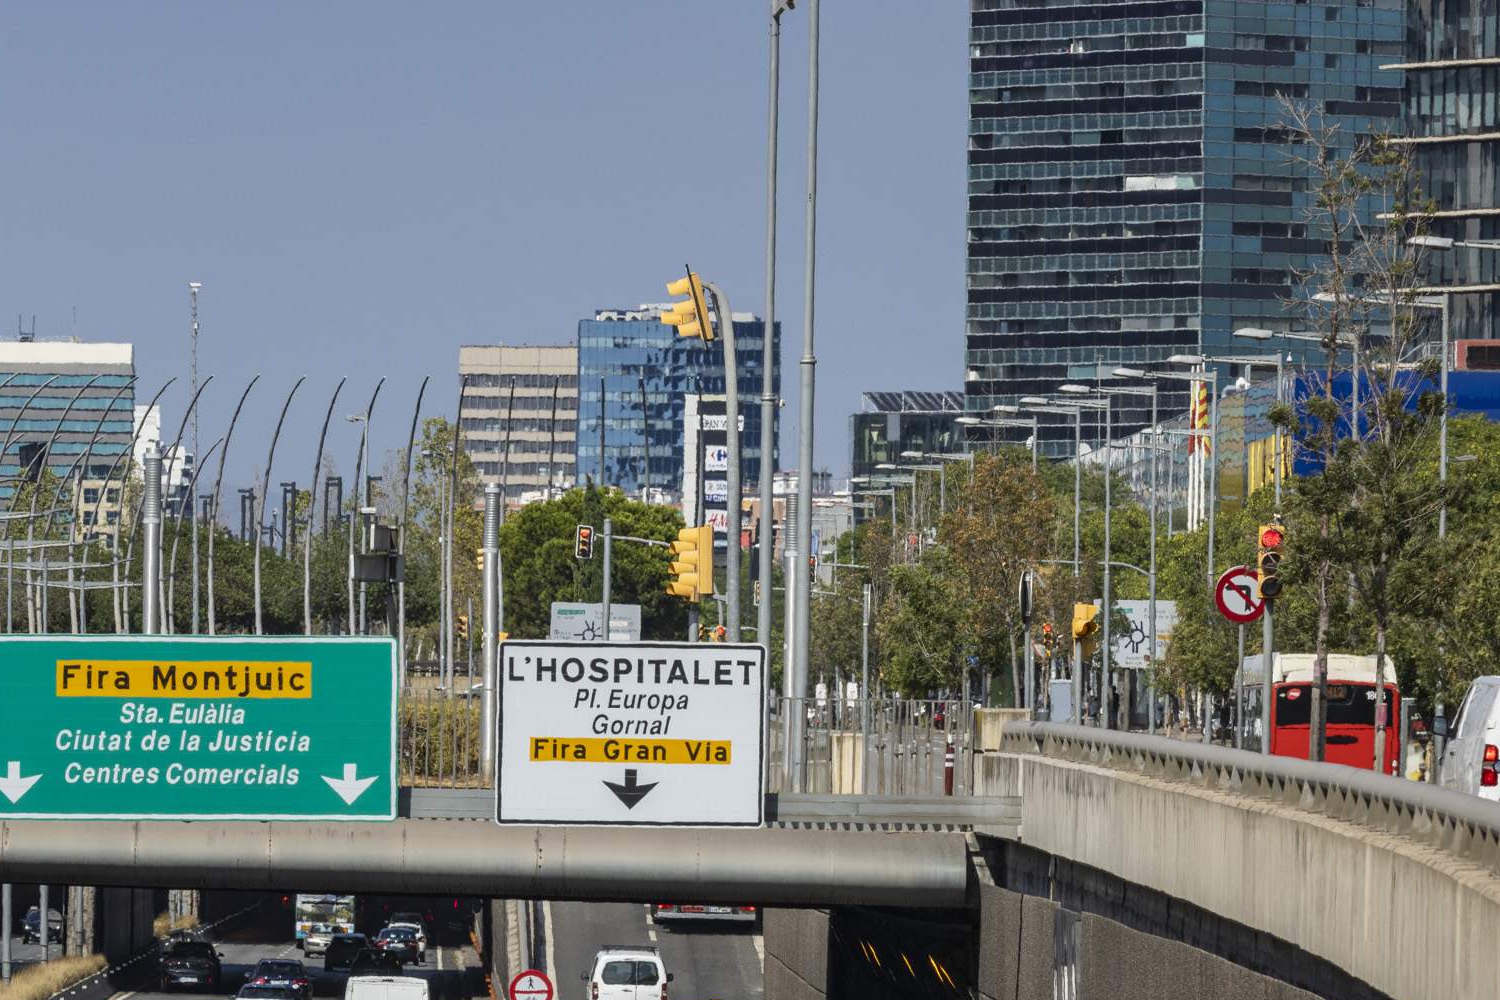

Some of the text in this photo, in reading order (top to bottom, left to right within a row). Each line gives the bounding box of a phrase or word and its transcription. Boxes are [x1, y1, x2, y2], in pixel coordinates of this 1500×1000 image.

[62, 664, 305, 697] Fira Montjuic
[508, 656, 757, 686] L'HOSPITALET
[119, 702, 245, 724] Sta. Eulàlia
[574, 688, 689, 715] Pl. Europa
[592, 714, 672, 735] Gornal
[55, 729, 132, 751] Ciutat
[140, 730, 170, 752] de
[179, 730, 201, 752] la
[534, 738, 728, 762] Fira Gran Via
[64, 762, 299, 785] Centres Comercials
